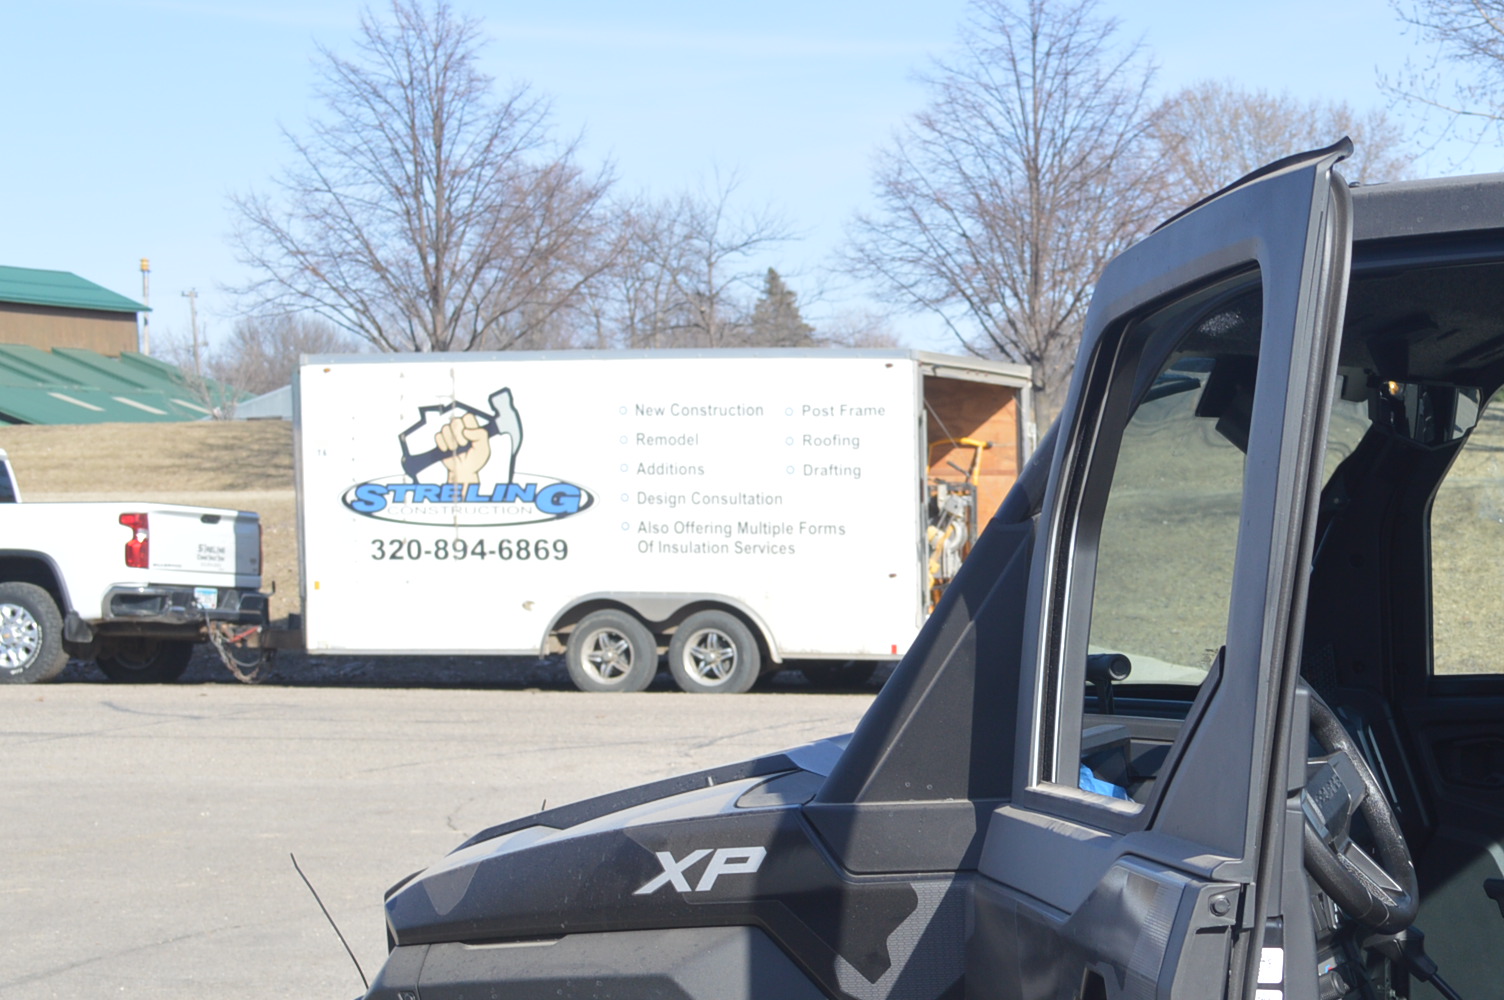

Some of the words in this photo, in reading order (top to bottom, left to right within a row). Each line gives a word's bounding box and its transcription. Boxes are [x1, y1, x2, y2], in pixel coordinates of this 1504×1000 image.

[635, 403, 665, 417] New
[671, 403, 764, 417] Construction
[802, 404, 835, 417] Post
[840, 404, 886, 417] Frame
[636, 432, 699, 446] Remodel
[802, 434, 860, 450] Roofing
[637, 461, 705, 476] Additions
[803, 464, 862, 479] Drafting
[350, 482, 582, 515] STRELING
[637, 491, 686, 508] Design
[691, 491, 783, 506] Consultation
[387, 505, 533, 515] CONSTRUCTION
[637, 521, 669, 534] Also
[674, 521, 732, 538] Offering
[737, 521, 794, 538] Multiple
[799, 521, 846, 535] Forms
[371, 538, 569, 561] 320-894-6869
[637, 540, 654, 554] Of
[658, 540, 729, 554] Insulation
[734, 540, 796, 555] Services
[632, 846, 767, 896] XP
